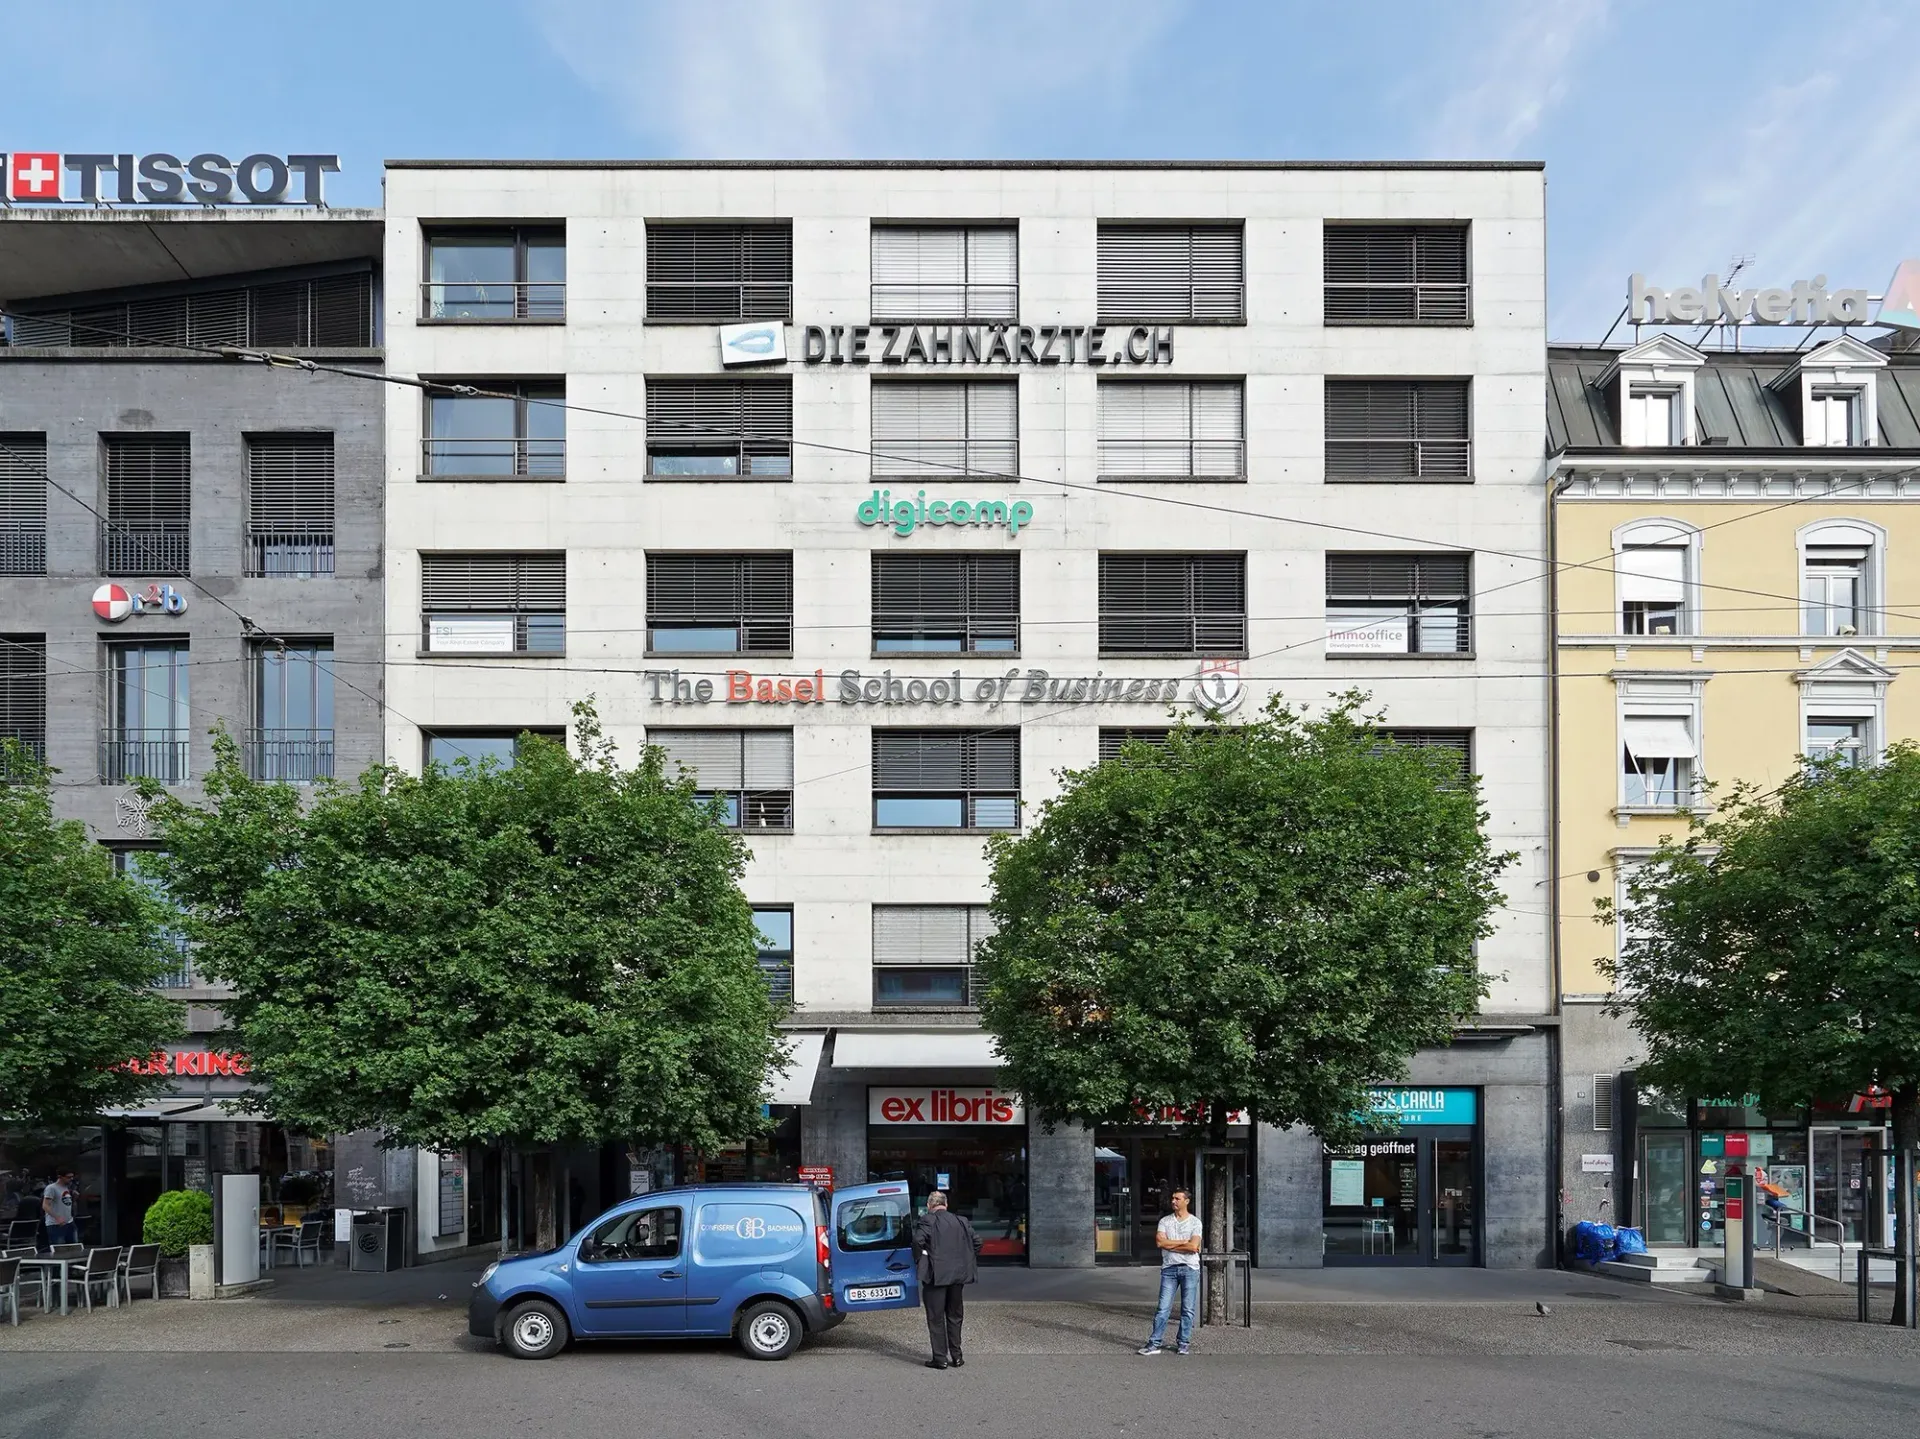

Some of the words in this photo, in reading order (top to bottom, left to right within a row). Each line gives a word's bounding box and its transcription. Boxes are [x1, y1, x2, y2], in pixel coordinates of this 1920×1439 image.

[64, 153, 341, 203] TISSOT
[1627, 273, 1868, 324] helvetia
[857, 489, 1034, 537] digicomp
[1329, 630, 1402, 641] Immooffice
[645, 668, 713, 703] The
[726, 668, 826, 704] Basel
[840, 668, 964, 704] School
[975, 667, 1020, 709] of
[1021, 667, 1181, 704] Business
[881, 1097, 925, 1122] ex
[931, 1090, 1013, 1122] libris
[1401, 1090, 1444, 1109] CARLA
[1370, 1141, 1415, 1156] geöffnet
[700, 1224, 735, 1232] CONFISERIE
[767, 1224, 803, 1232] BACHMANN
[857, 1290, 867, 1299] BS
[870, 1288, 893, 1298] 63314
